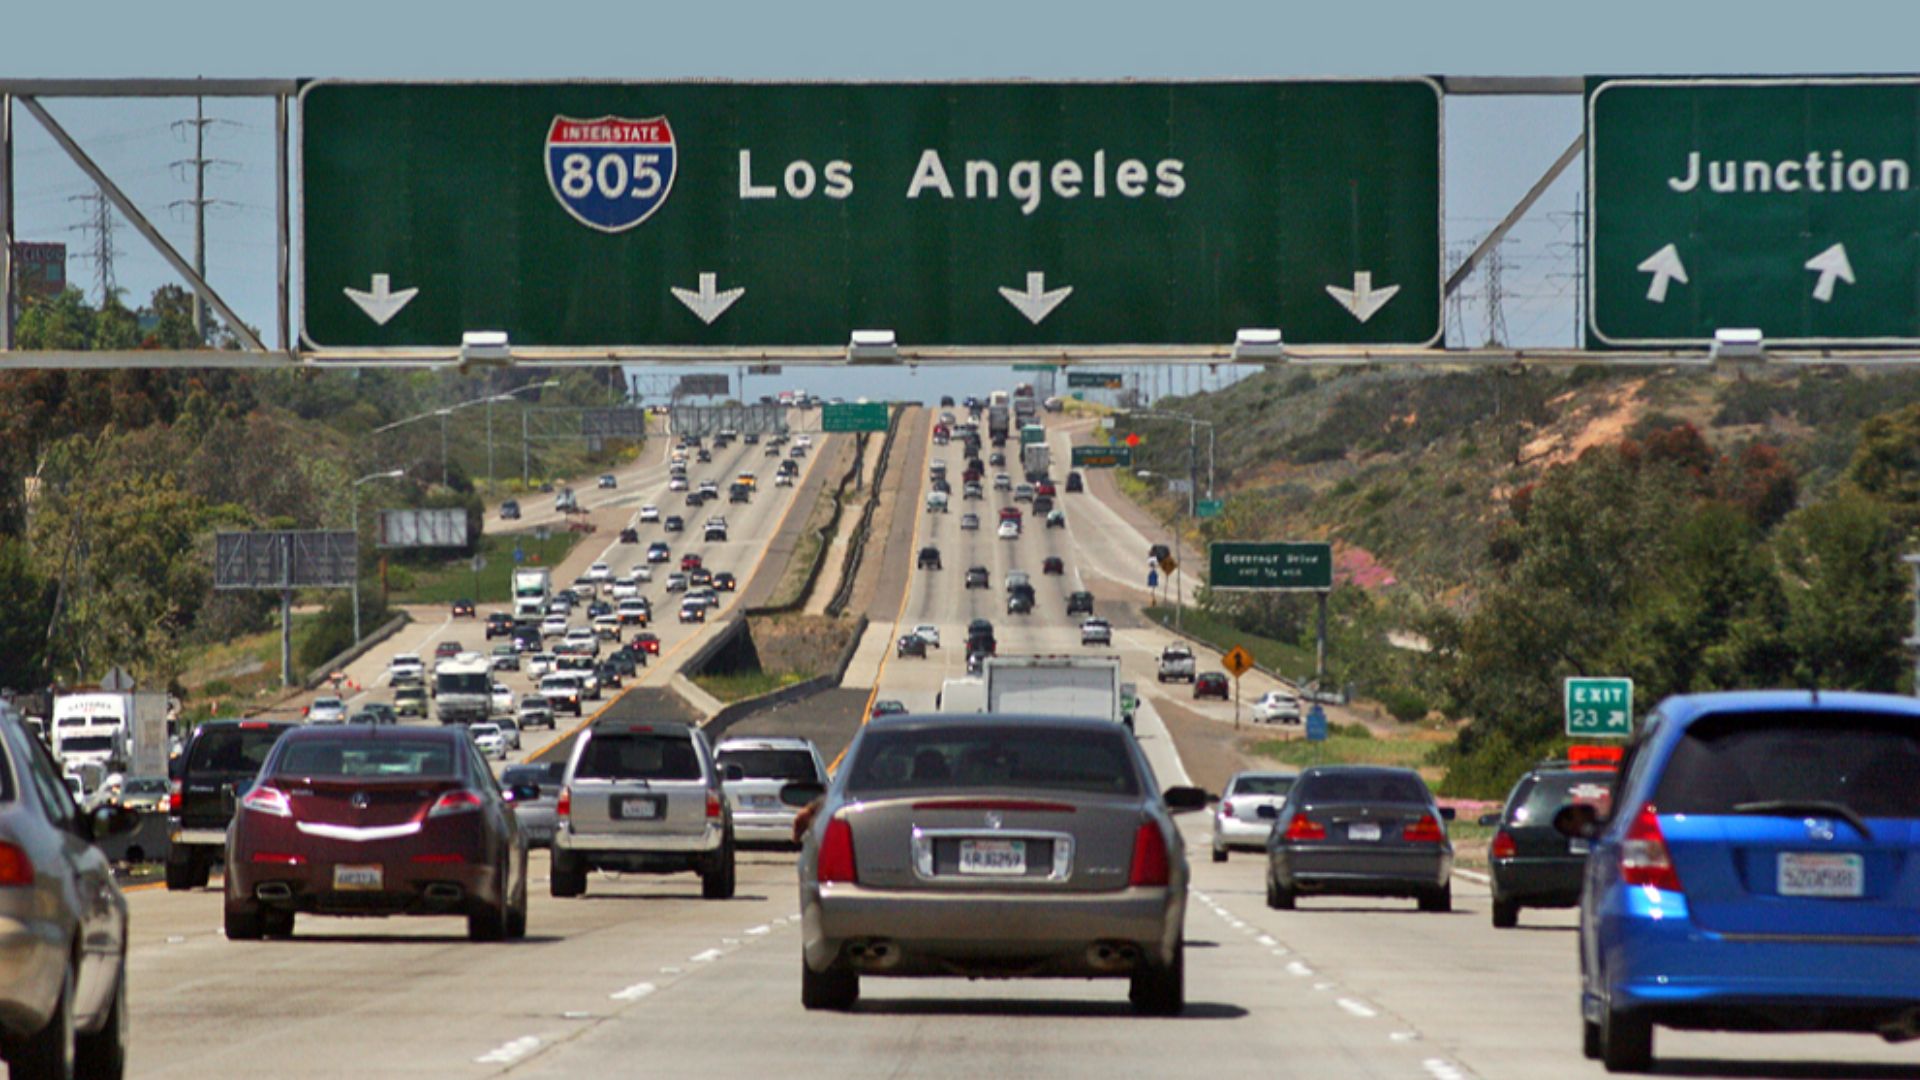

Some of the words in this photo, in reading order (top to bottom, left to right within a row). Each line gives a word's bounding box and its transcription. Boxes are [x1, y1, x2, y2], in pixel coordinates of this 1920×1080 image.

[562, 126, 660, 141] INTERSTATE
[561, 153, 662, 199] 805
[738, 149, 854, 199] Los
[906, 149, 1187, 215] Angeles
[1667, 149, 1910, 193] Junction
[1574, 687, 1623, 703] EXIT
[1572, 708, 1599, 727] 23
